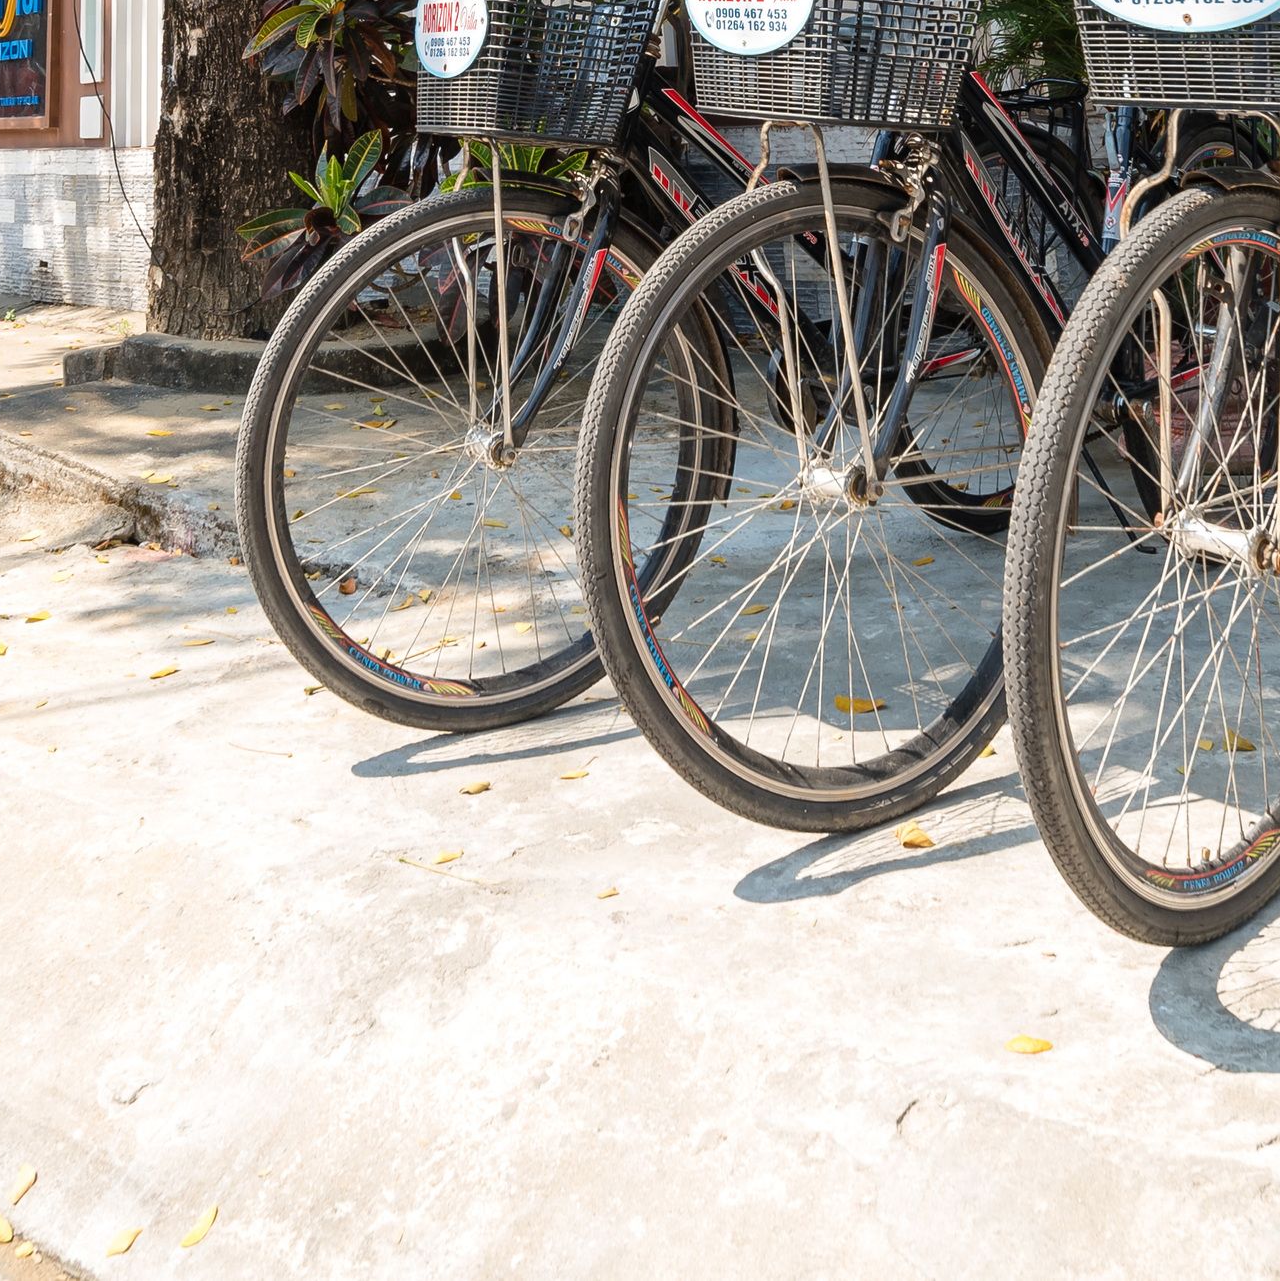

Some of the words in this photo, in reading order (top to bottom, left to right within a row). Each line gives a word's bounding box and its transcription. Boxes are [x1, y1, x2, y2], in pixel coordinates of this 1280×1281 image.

[422, 2, 453, 33] HORIZON
[454, 1, 460, 31] 2
[715, 7, 741, 19] 0906
[744, 8, 763, 19] 467
[767, 9, 788, 20] 453
[716, 19, 745, 31] 01264
[749, 20, 765, 31] 162
[769, 21, 788, 32] 934
[446, 37, 457, 46] 467
[1059, 201, 1083, 232] ATX
[981, 307, 1014, 361] STANDARD
[1009, 361, 1028, 404] TAIWAN
[646, 634, 675, 688] POWER
[381, 666, 422, 689] POWER
